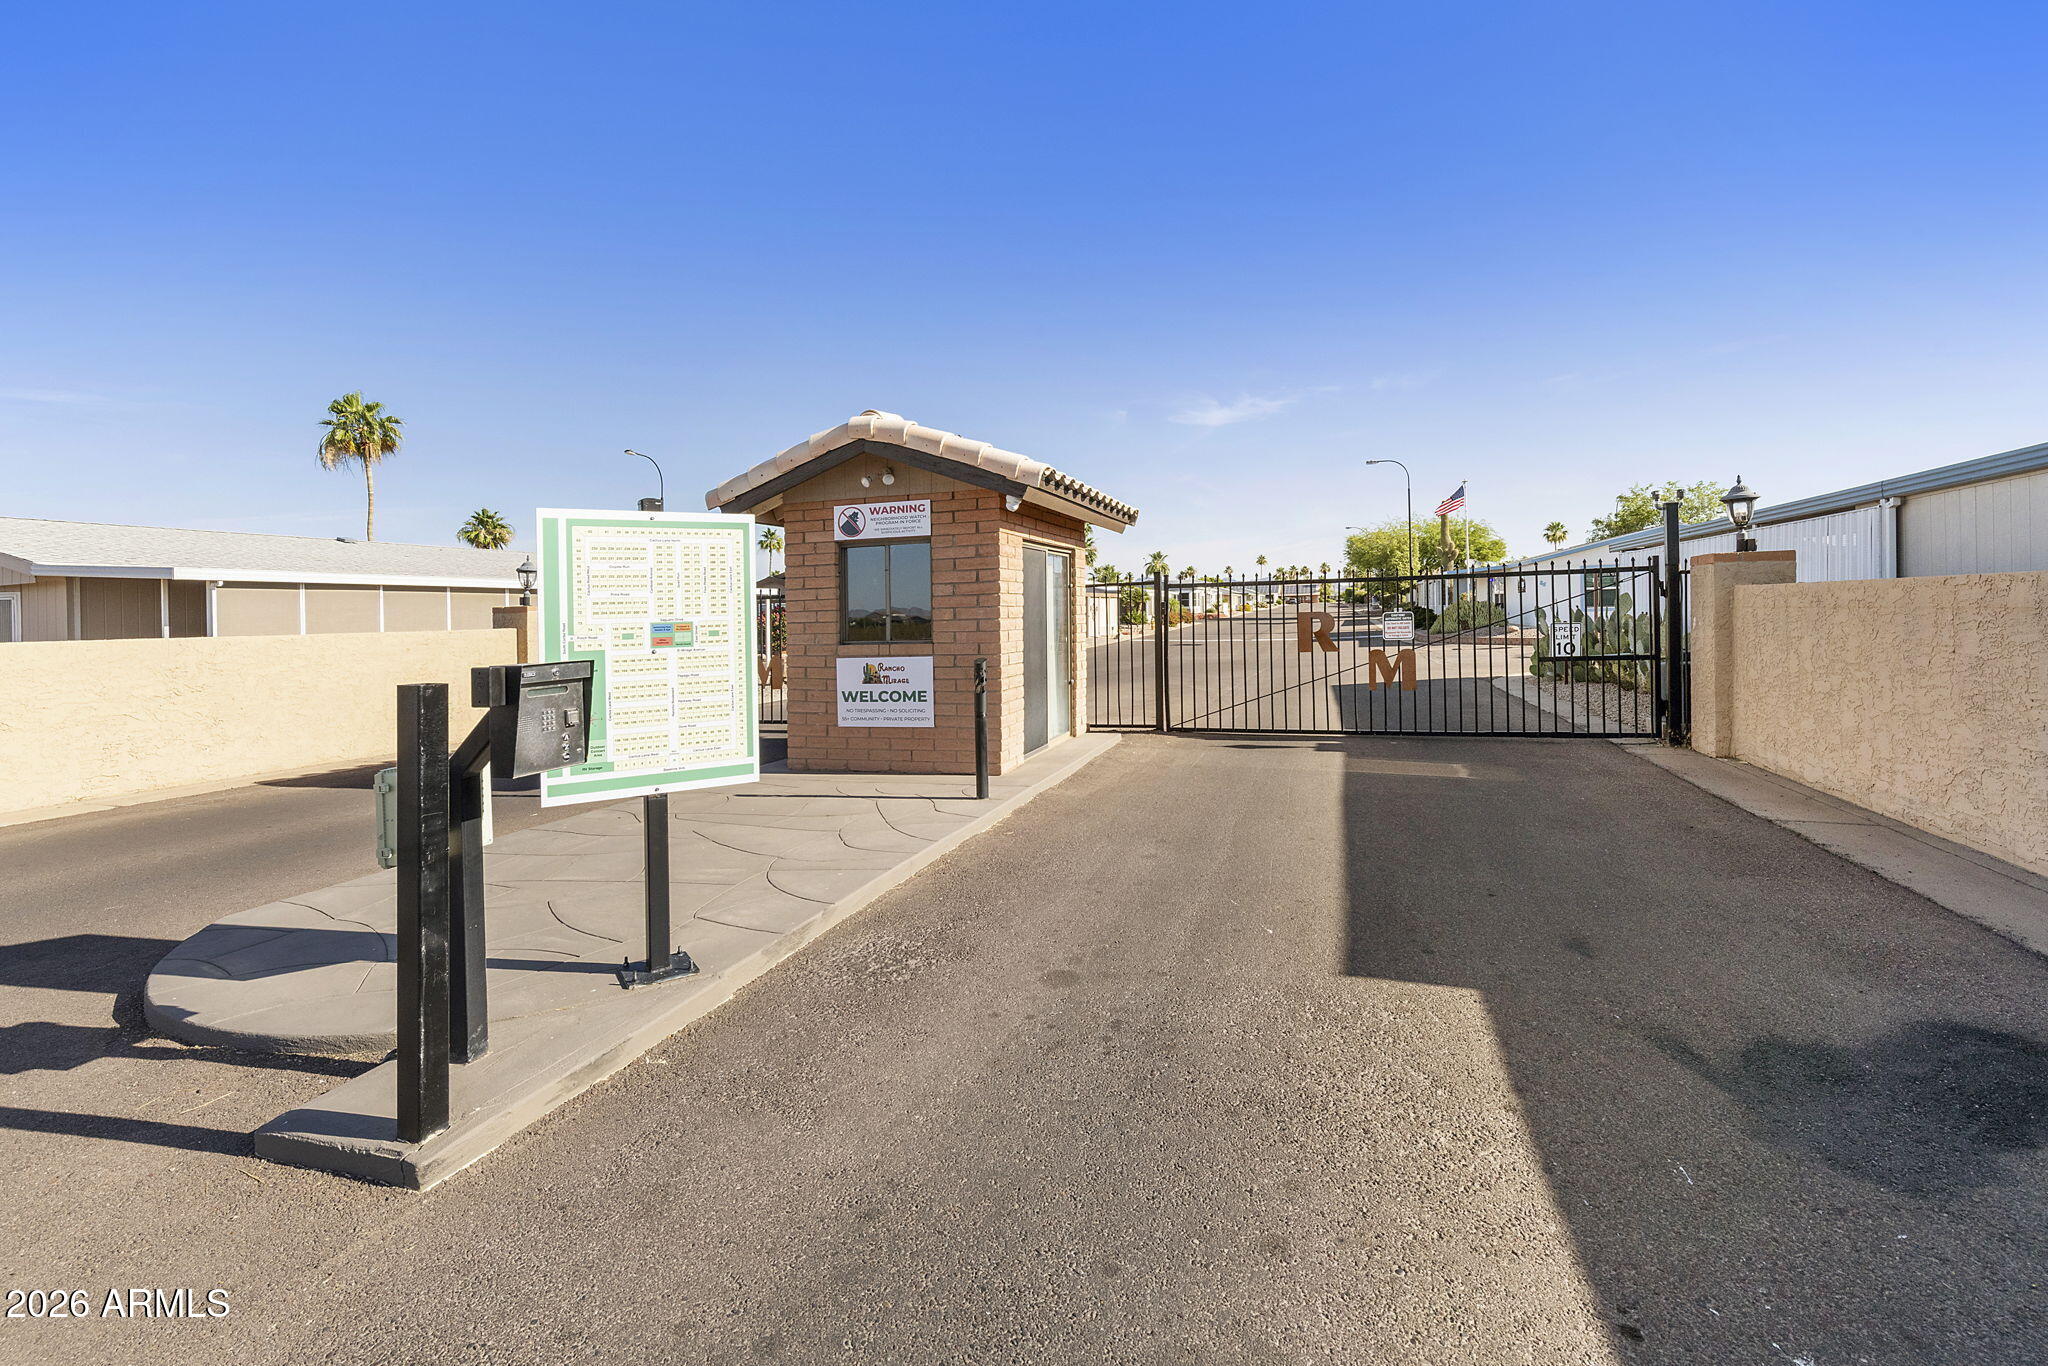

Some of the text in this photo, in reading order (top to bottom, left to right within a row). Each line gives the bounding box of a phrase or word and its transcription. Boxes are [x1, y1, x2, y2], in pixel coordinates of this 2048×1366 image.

[868, 504, 926, 515] WARNING
[1297, 612, 1339, 652] R
[1557, 642, 1575, 655] 10
[1369, 649, 1416, 691] M
[842, 691, 927, 702] WELCOME
